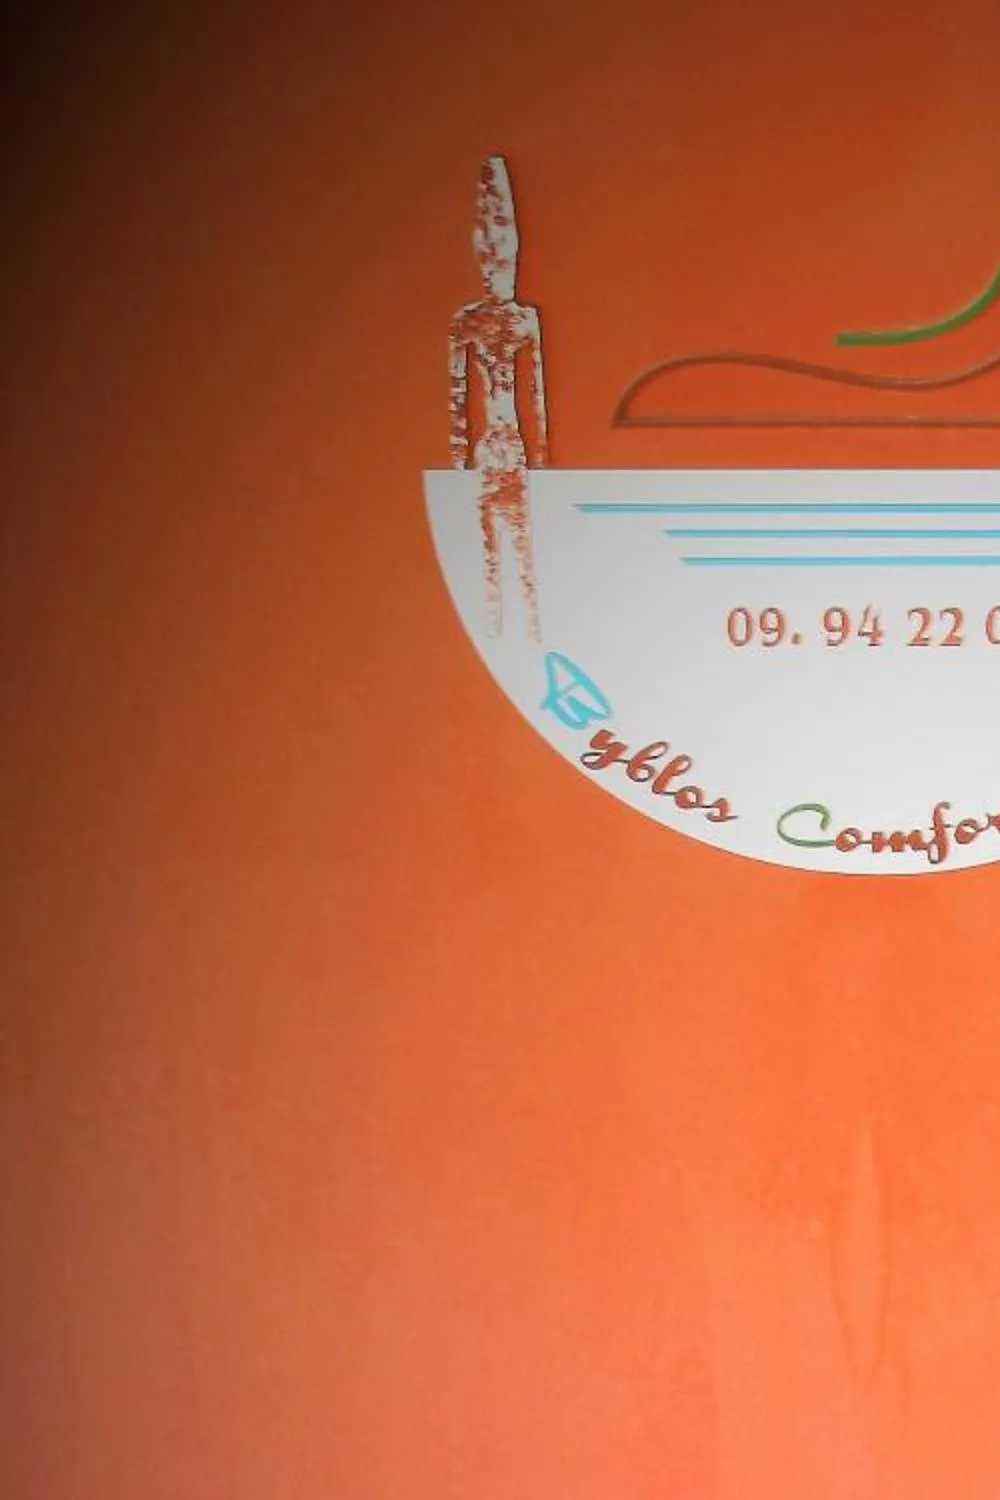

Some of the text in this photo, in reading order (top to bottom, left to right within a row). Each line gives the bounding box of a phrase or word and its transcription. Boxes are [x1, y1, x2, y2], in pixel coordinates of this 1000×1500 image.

[727, 606, 801, 647] 09.
[822, 604, 883, 647] 94
[906, 606, 964, 647] 22
[539, 651, 738, 823] Byblos
